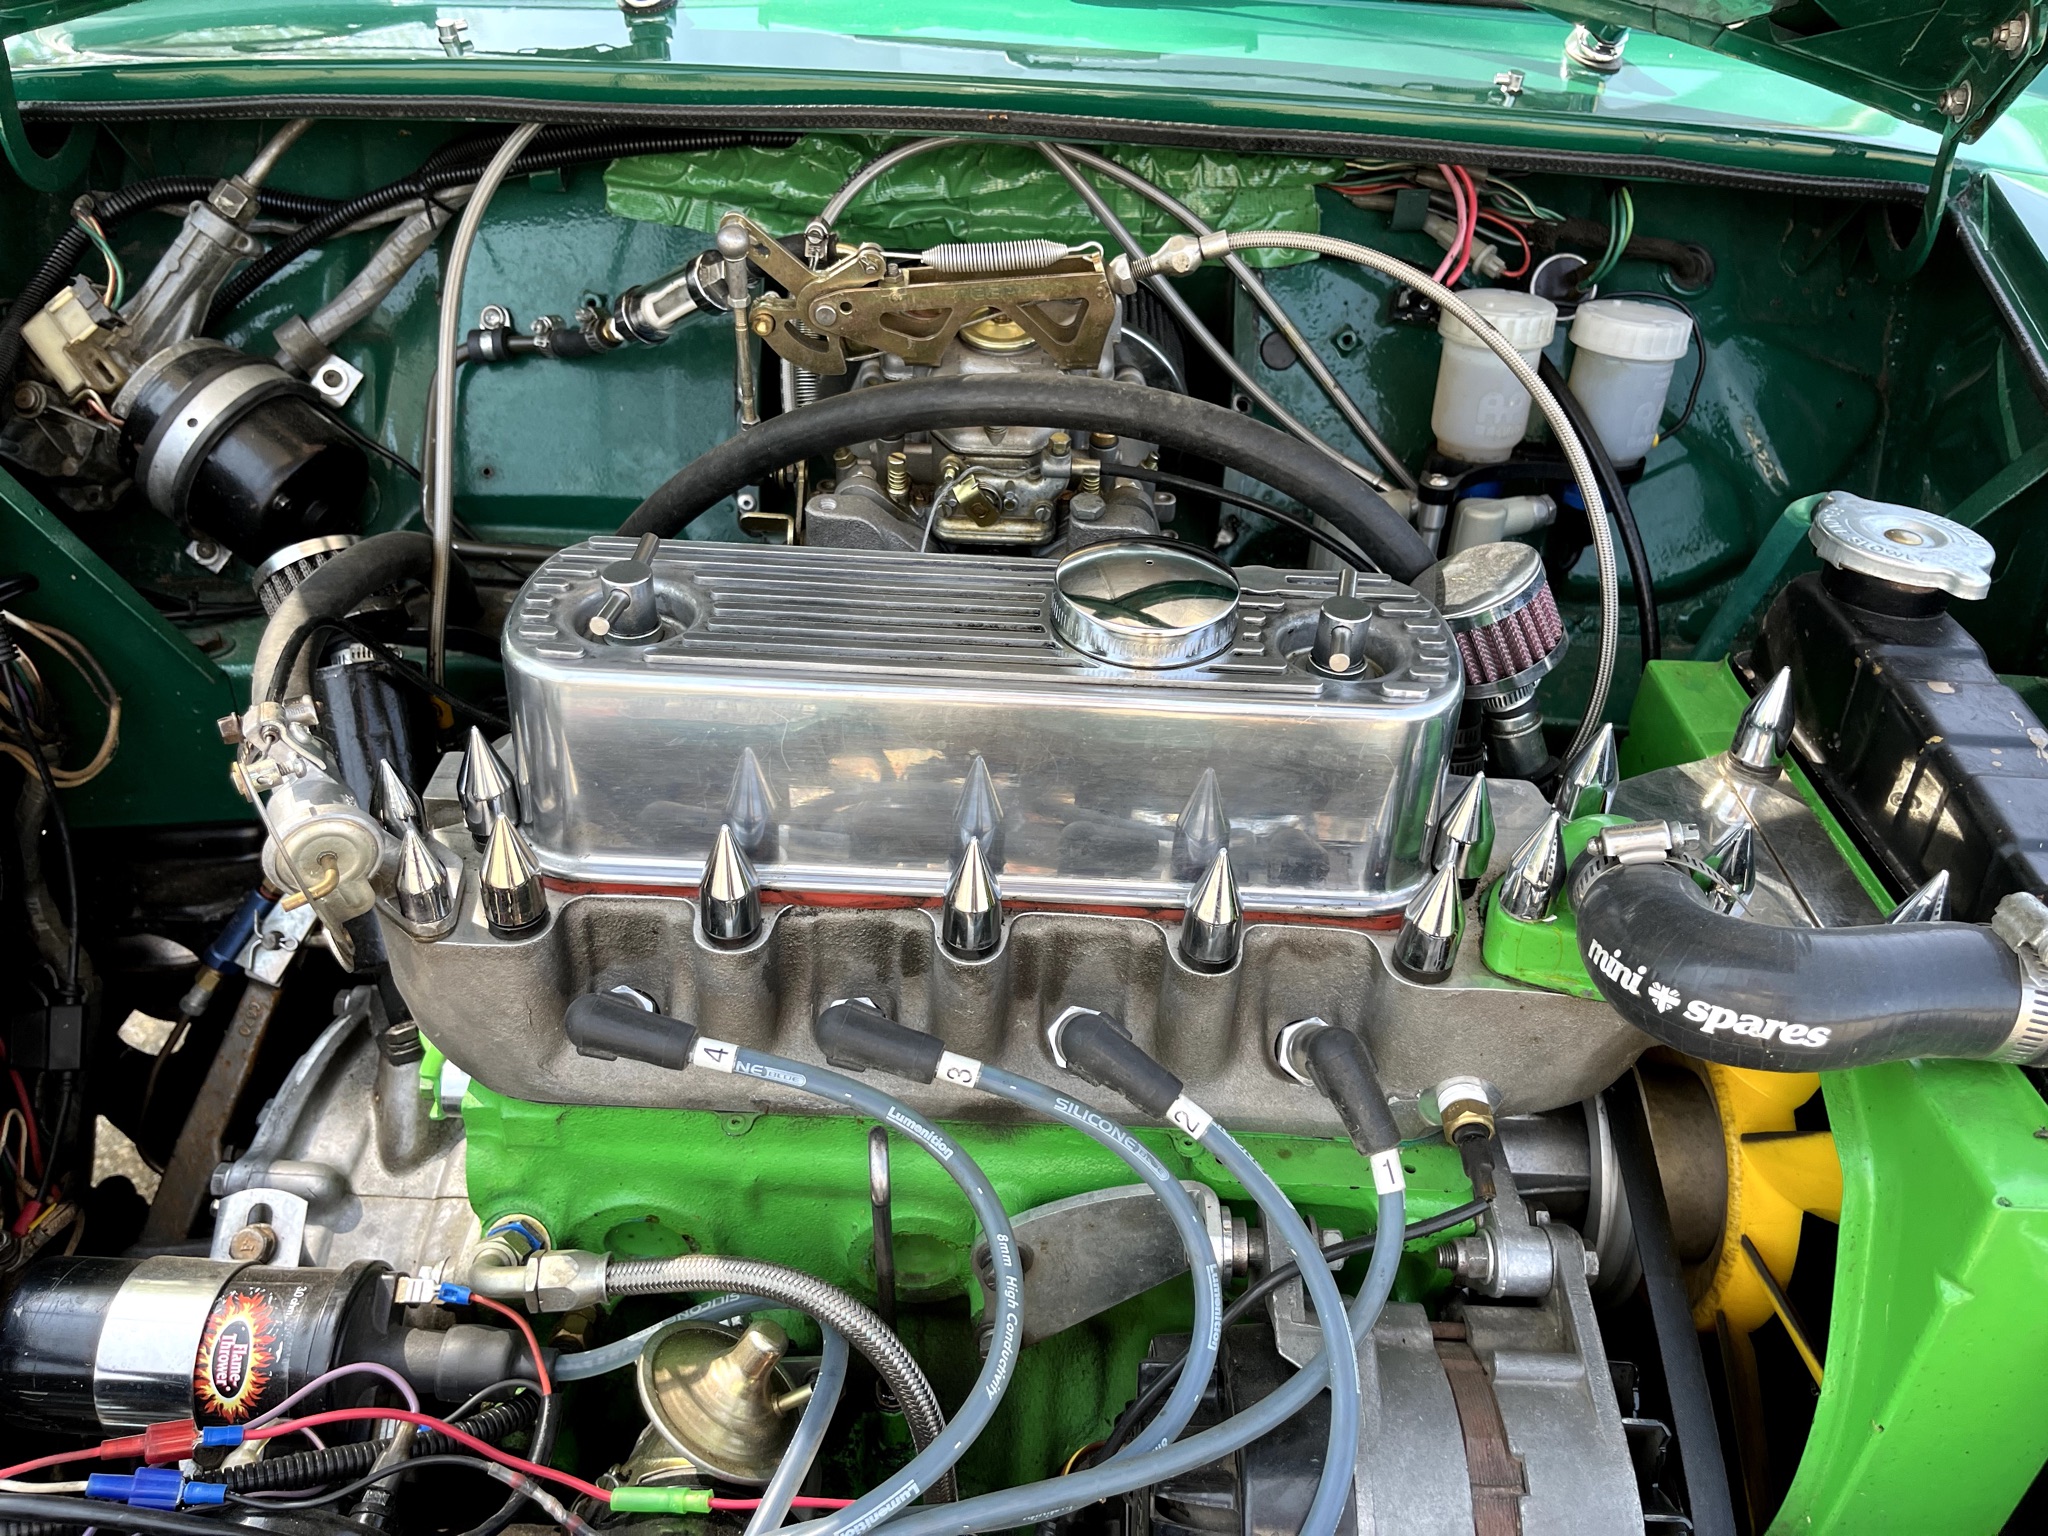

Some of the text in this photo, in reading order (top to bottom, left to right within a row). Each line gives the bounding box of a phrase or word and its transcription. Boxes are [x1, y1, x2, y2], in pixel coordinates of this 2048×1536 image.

[1587, 938, 1832, 1048] mini spares
[703, 1047, 729, 1063] 4
[946, 1066, 973, 1084] 3
[887, 1106, 954, 1158] Lumenition
[1054, 1097, 1139, 1150] SILICONE
[1174, 1110, 1200, 1133] 2
[1382, 1158, 1395, 1184] 1
[985, 1233, 1019, 1400] 8mm High Conductivity
[1207, 1263, 1223, 1350] Lumenition
[216, 1333, 237, 1388] Thrower
